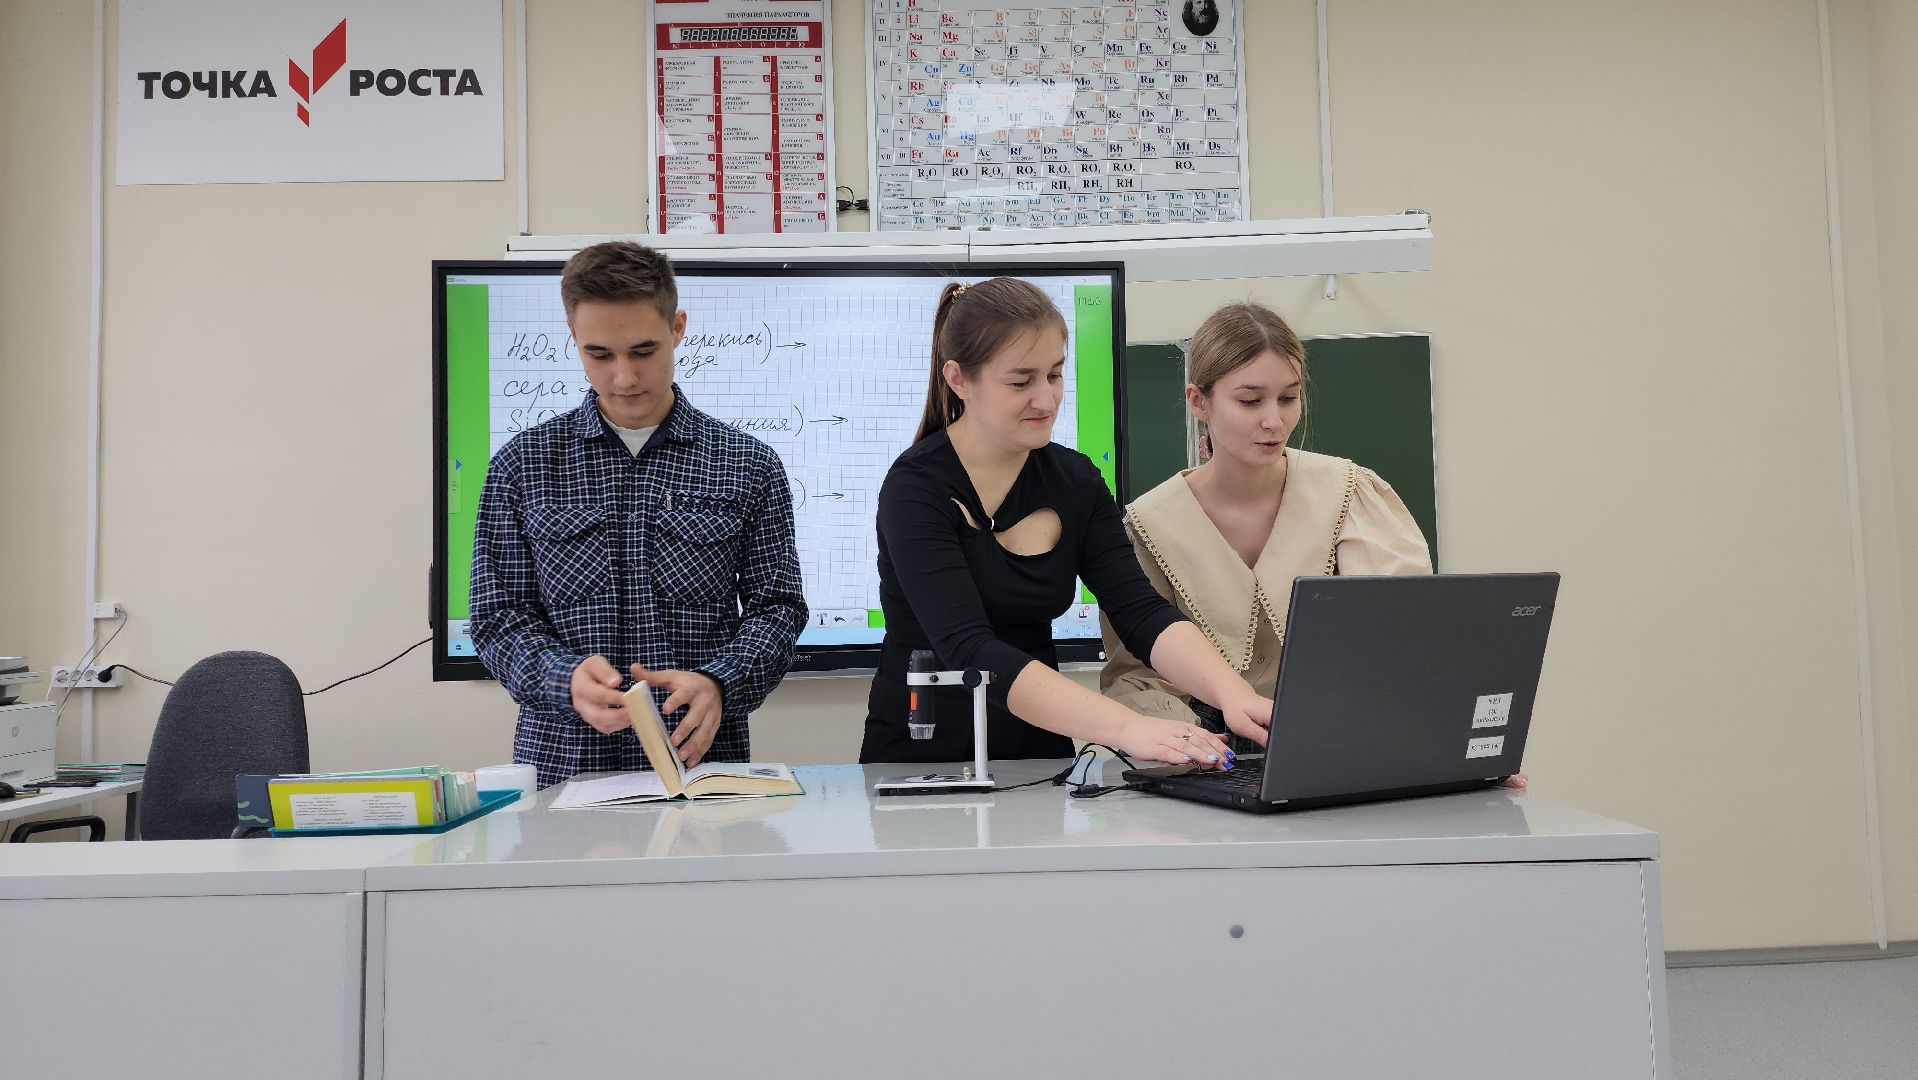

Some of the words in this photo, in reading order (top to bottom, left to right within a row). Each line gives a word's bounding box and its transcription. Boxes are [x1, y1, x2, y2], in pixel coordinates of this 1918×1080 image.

[909, 15, 919, 23] Li
[942, 14, 954, 23] Be
[1062, 10, 1068, 19] N
[943, 32, 958, 42] Mg
[1074, 45, 1086, 54] Cr
[1106, 44, 1122, 52] Mn
[1140, 43, 1151, 52] Fe
[1173, 42, 1186, 50] Co
[1205, 41, 1216, 50] Ni
[910, 49, 917, 57] K
[943, 48, 956, 56] Ca
[1157, 58, 1169, 66] Kr
[925, 64, 938, 73] Cu
[959, 64, 972, 72] Zn
[1174, 74, 1188, 82] Rh
[1207, 74, 1219, 82] Pd
[138, 70, 277, 99] ТОЧКА
[350, 68, 484, 96] РОСТА
[911, 82, 924, 90] Rb
[927, 98, 939, 107] Ag
[1075, 111, 1086, 119] W
[1109, 110, 1121, 118] Re
[1142, 109, 1155, 118] Os
[1175, 108, 1183, 117] Ir
[1076, 146, 1088, 155] Sg
[1143, 144, 1156, 152] Hs
[1176, 142, 1190, 151] Mt
[952, 167, 968, 176] RO
[1117, 179, 1133, 187] RH
[1100, 195, 1110, 204] Dy
[1512, 605, 1542, 616] acer
